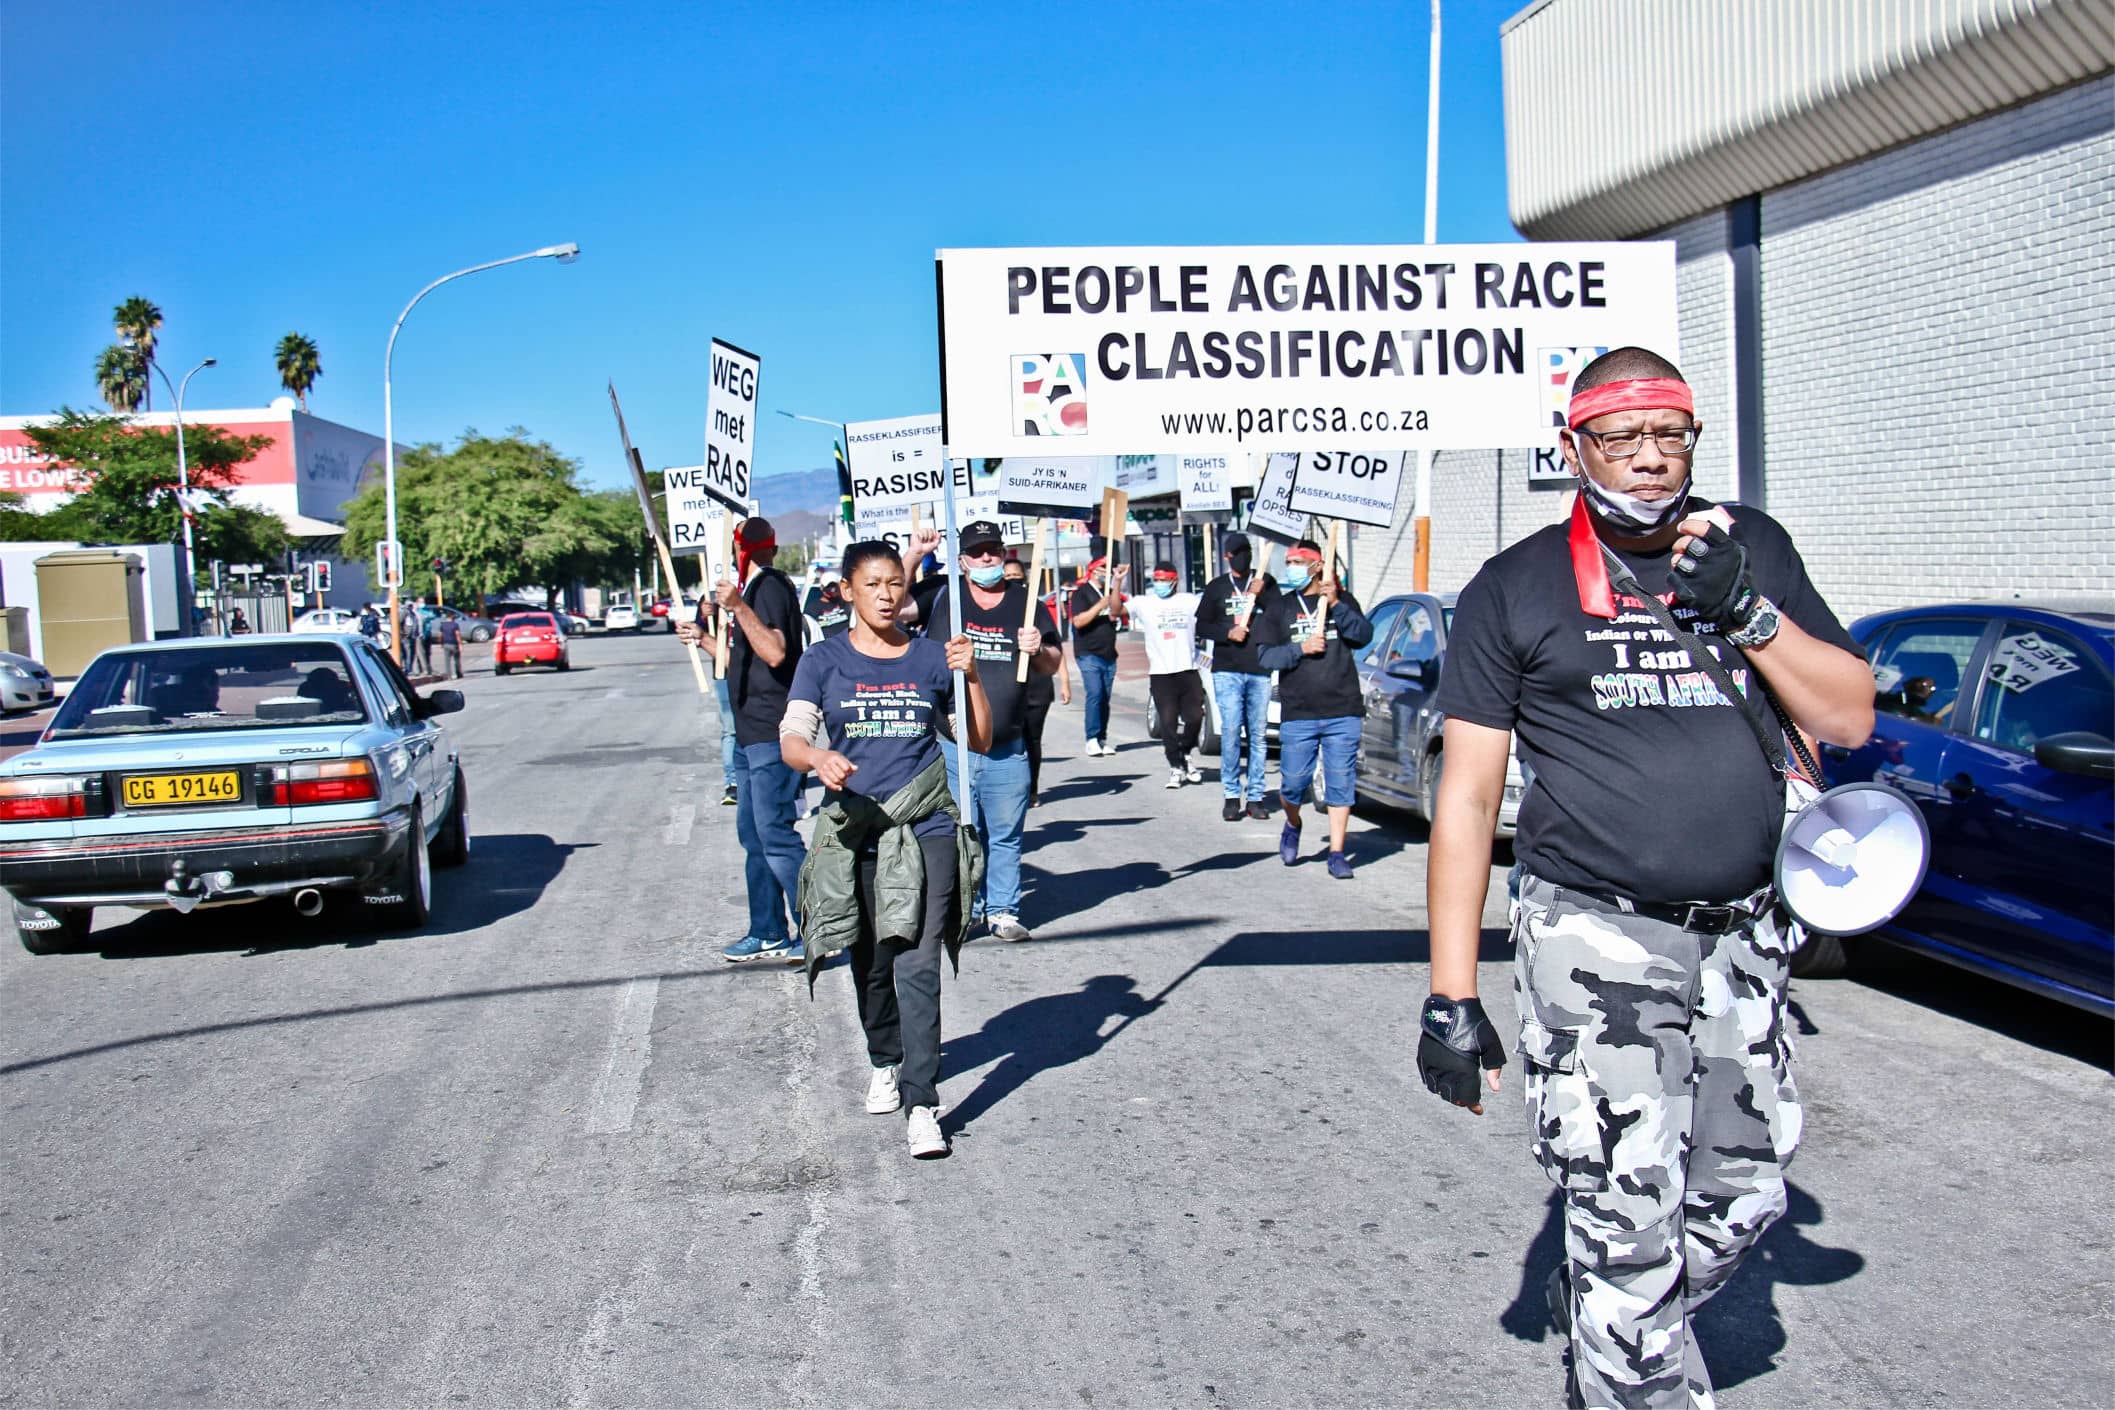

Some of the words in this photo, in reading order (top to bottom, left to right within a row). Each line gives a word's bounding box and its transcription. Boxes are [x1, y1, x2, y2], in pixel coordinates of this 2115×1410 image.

[1008, 265, 1210, 314] PEOPLE
[1227, 263, 1455, 312] AGAINST
[1475, 261, 1607, 309] RACE
[1097, 327, 1524, 381] CLASSIFICATION
[713, 353, 754, 402] WEG
[715, 408, 745, 444] met
[849, 426, 943, 443] RASSEKLASSIFISER
[1161, 407, 1429, 442] www.parcsa.co.za
[892, 450, 905, 462] is
[1183, 457, 1226, 469] RIGHTS
[1313, 452, 1388, 480] STOP
[15, 467, 93, 488] LOWES
[669, 470, 703, 489] WE
[706, 443, 749, 498] RAS
[1032, 467, 1044, 476] JY
[1046, 468, 1055, 477] IS
[1199, 470, 1212, 479] for
[1285, 469, 1295, 480] d
[854, 467, 967, 498] RASISME
[1008, 477, 1088, 492] SUID-AFRIKANER
[1276, 487, 1291, 500] RA
[1295, 485, 1393, 511] RASSEKLASSIFISERING
[861, 509, 884, 519] What
[886, 508, 894, 516] is
[895, 506, 909, 515] the
[966, 507, 975, 517] is
[1262, 499, 1303, 522] OPSIES
[674, 522, 706, 543] RA
[1585, 629, 1631, 642] Indian
[1633, 631, 1648, 641] or
[1649, 629, 1676, 642] Wh
[1692, 621, 1715, 636] Per
[1613, 643, 1631, 669] I
[1639, 650, 1692, 670] am
[856, 683, 878, 692] I'm
[883, 683, 905, 691] not
[909, 682, 918, 690] a
[1591, 673, 1666, 710] SOUTH
[857, 707, 866, 721] I
[871, 709, 900, 720] am
[905, 709, 916, 720] a
[129, 781, 155, 800] CG
[168, 775, 235, 799] 19146
[364, 895, 404, 905] TOYOTA
[20, 919, 61, 930] TOYOTA
